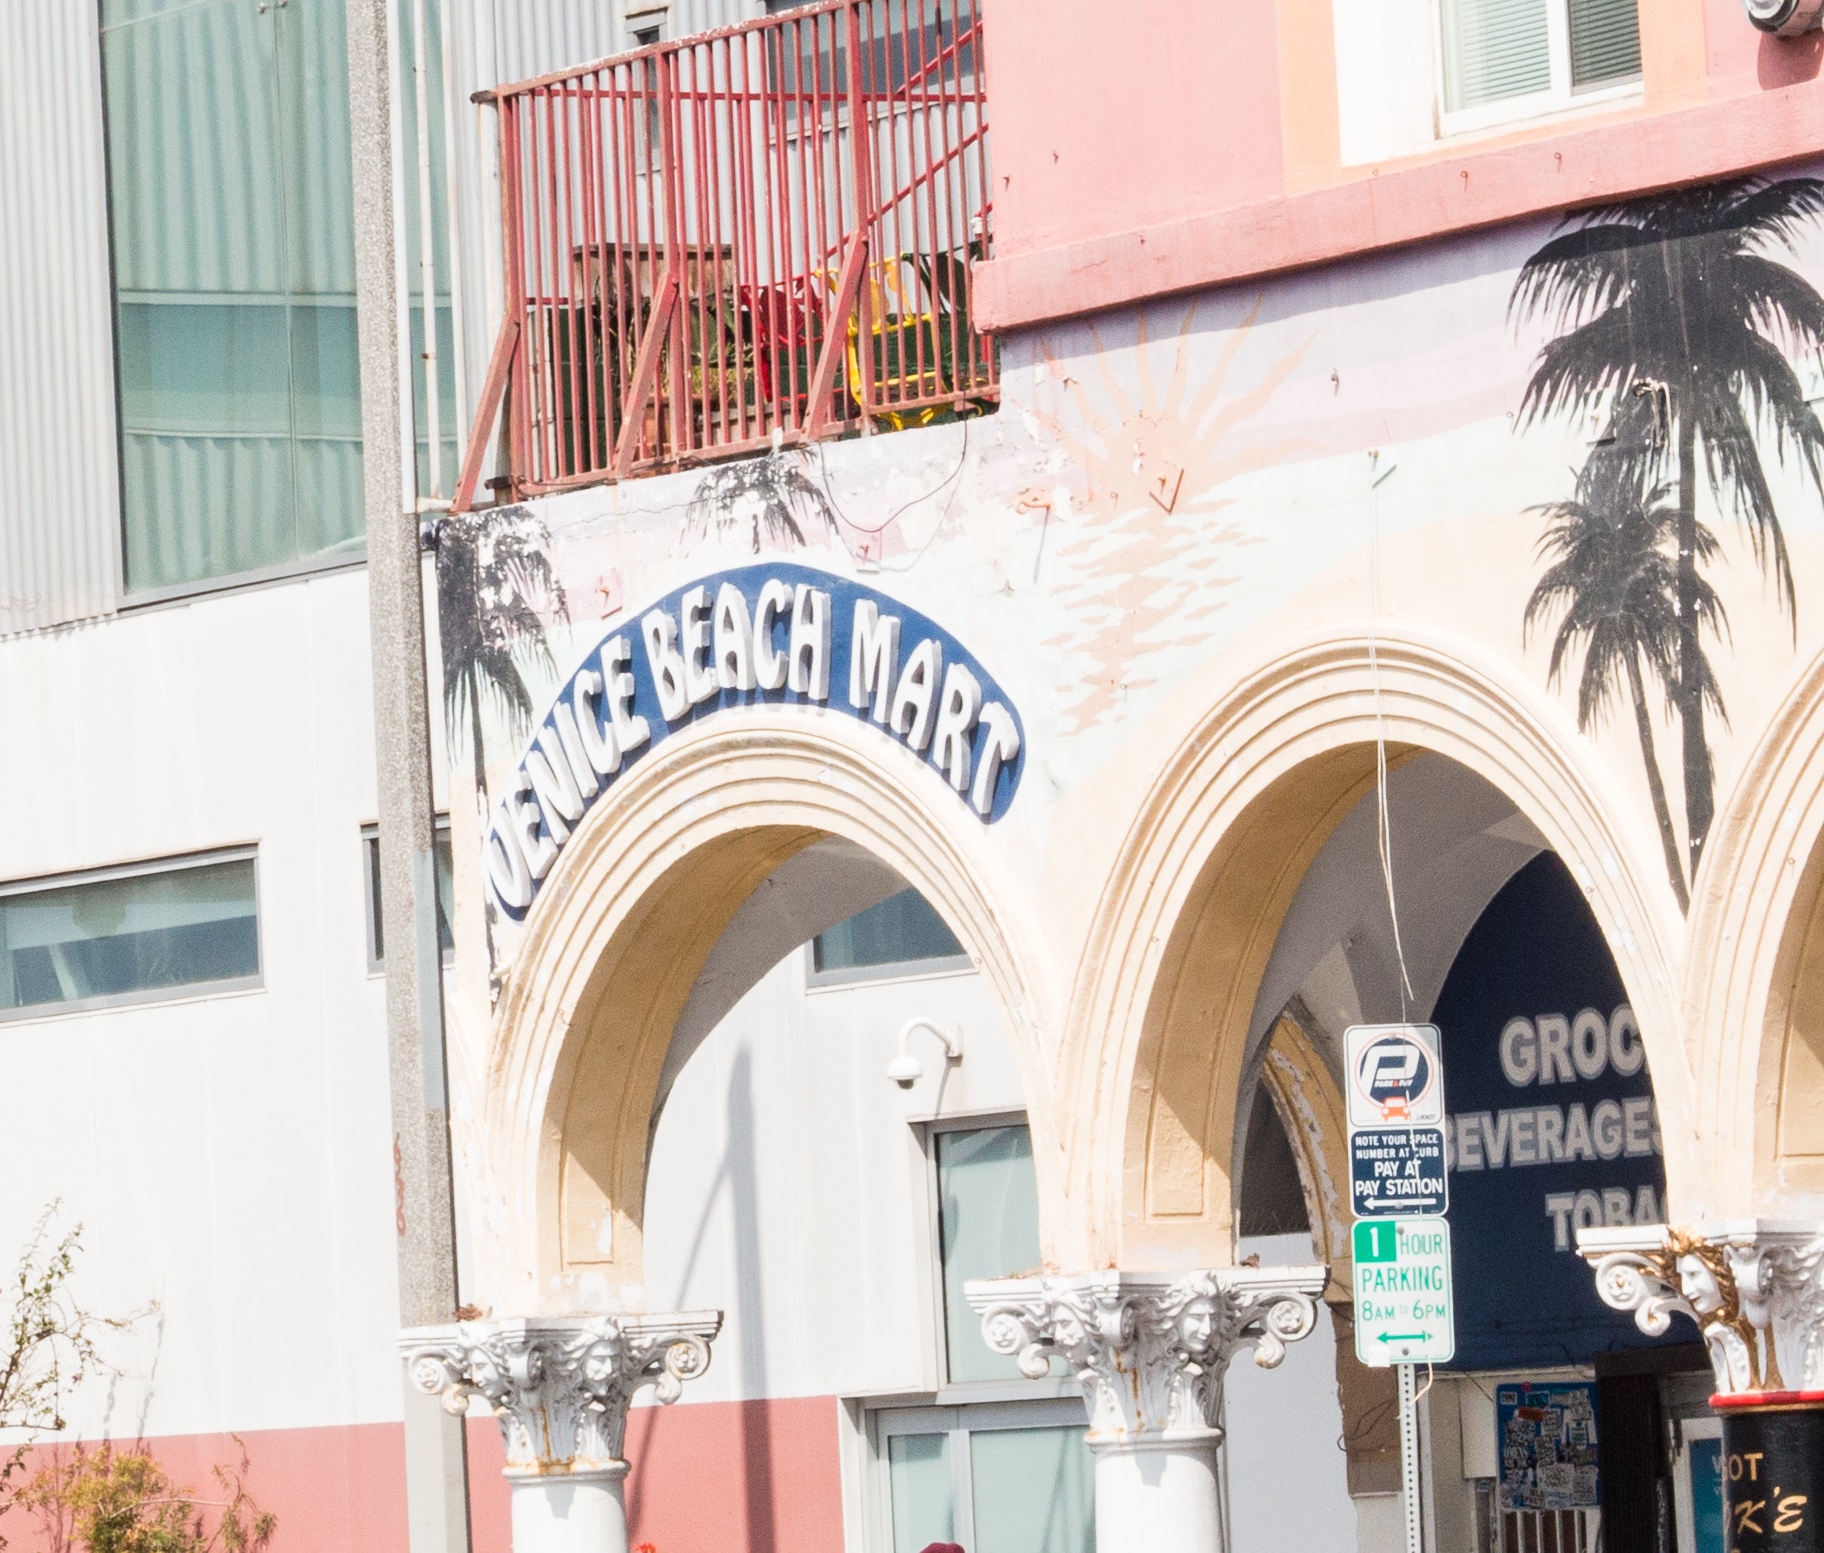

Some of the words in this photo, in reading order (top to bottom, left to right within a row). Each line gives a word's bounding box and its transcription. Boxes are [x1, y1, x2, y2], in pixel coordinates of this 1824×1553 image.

[483, 634, 650, 908] VENICE
[641, 577, 831, 722] BEACH
[849, 597, 1020, 815] MART
[1499, 1003, 1651, 1087] GROC
[1355, 1135, 1380, 1146] NOTE
[1381, 1134, 1407, 1146] YOUR
[1409, 1133, 1439, 1145] SPACE
[1356, 1149, 1396, 1159] NUMBER
[1398, 1148, 1410, 1158] AT
[1414, 1147, 1439, 1158] CURB
[1374, 1161, 1400, 1177] PAY
[1404, 1160, 1421, 1177] AT
[1355, 1180, 1381, 1197] PAY
[1385, 1178, 1443, 1196] STATION
[1545, 1185, 1669, 1253] TOBA
[1369, 1226, 1379, 1258] 1
[1400, 1233, 1444, 1255] HOUR
[1362, 1265, 1444, 1293] PARKING
[1362, 1300, 1395, 1322] 8AM
[1412, 1299, 1446, 1320] 6PM
